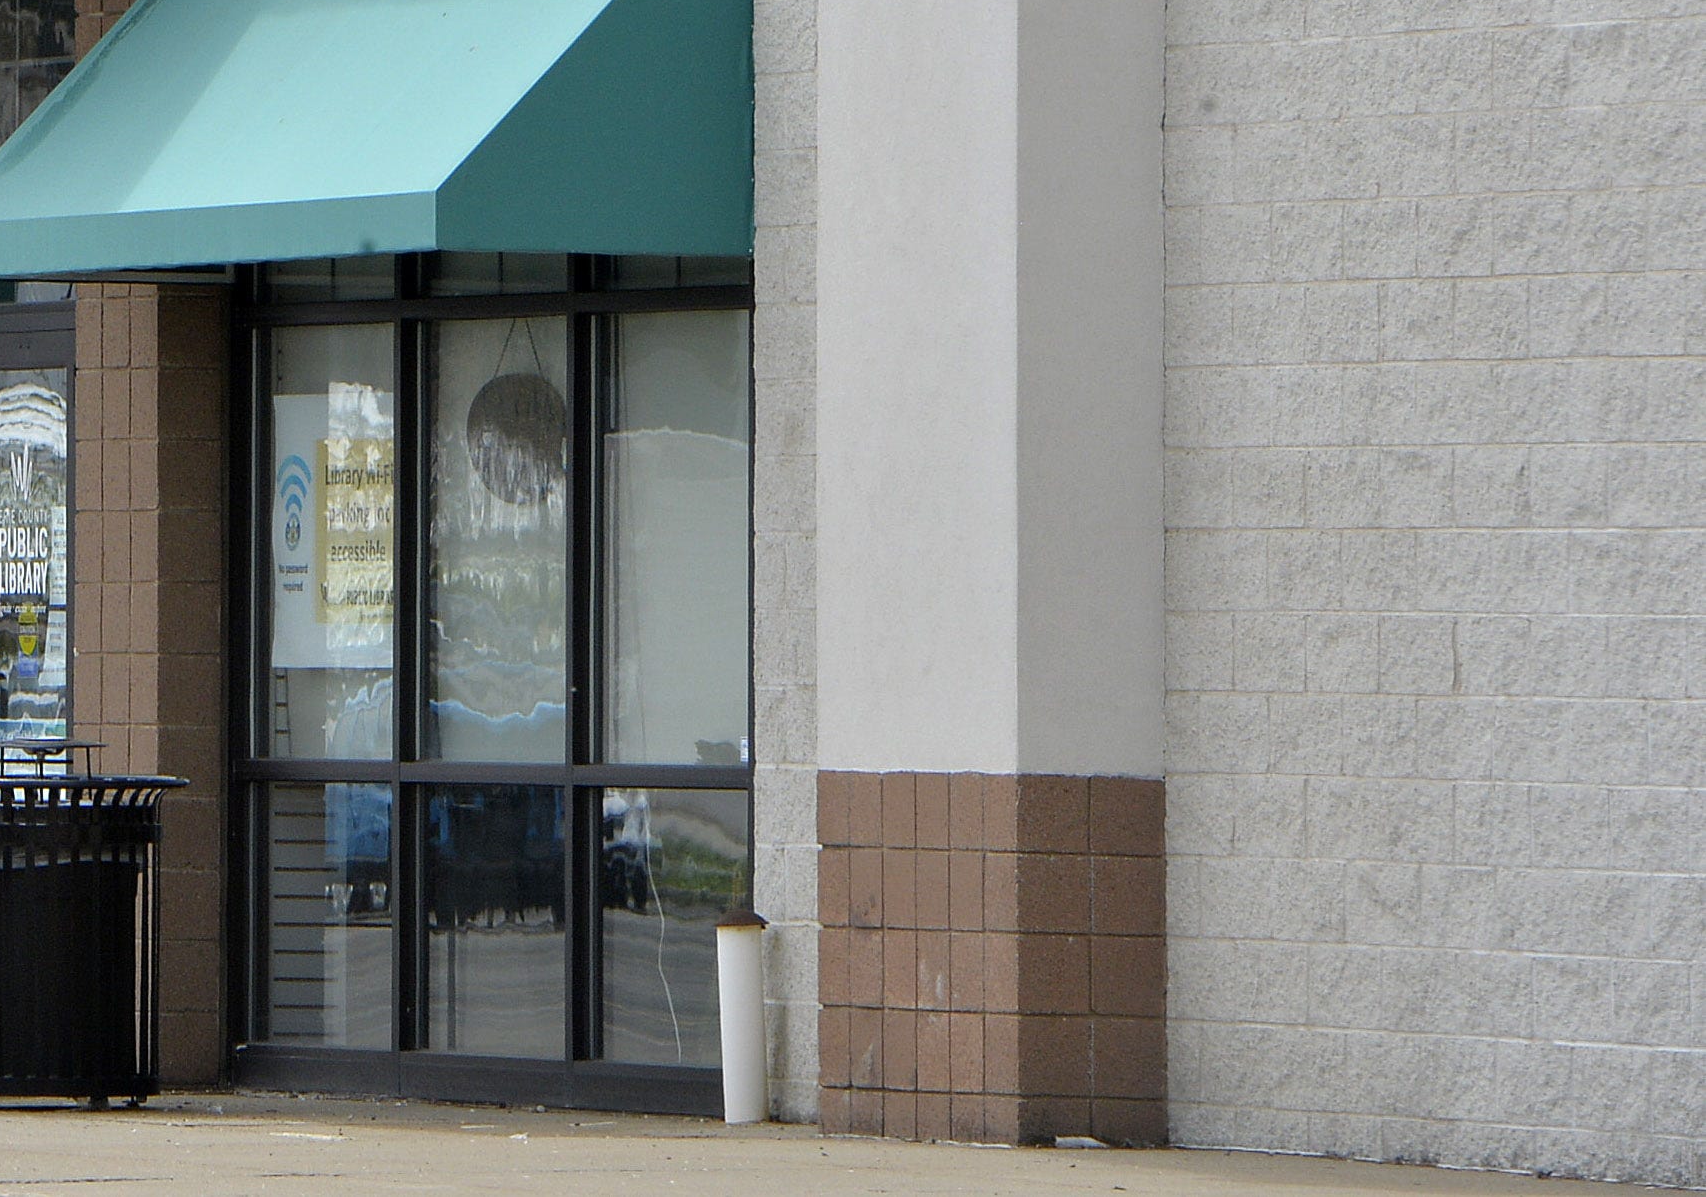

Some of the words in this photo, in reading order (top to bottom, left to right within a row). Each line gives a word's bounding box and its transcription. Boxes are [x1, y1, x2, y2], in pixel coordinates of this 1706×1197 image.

[325, 464, 364, 490] Library
[18, 509, 48, 524] COUNTY
[330, 539, 386, 562] accessible
